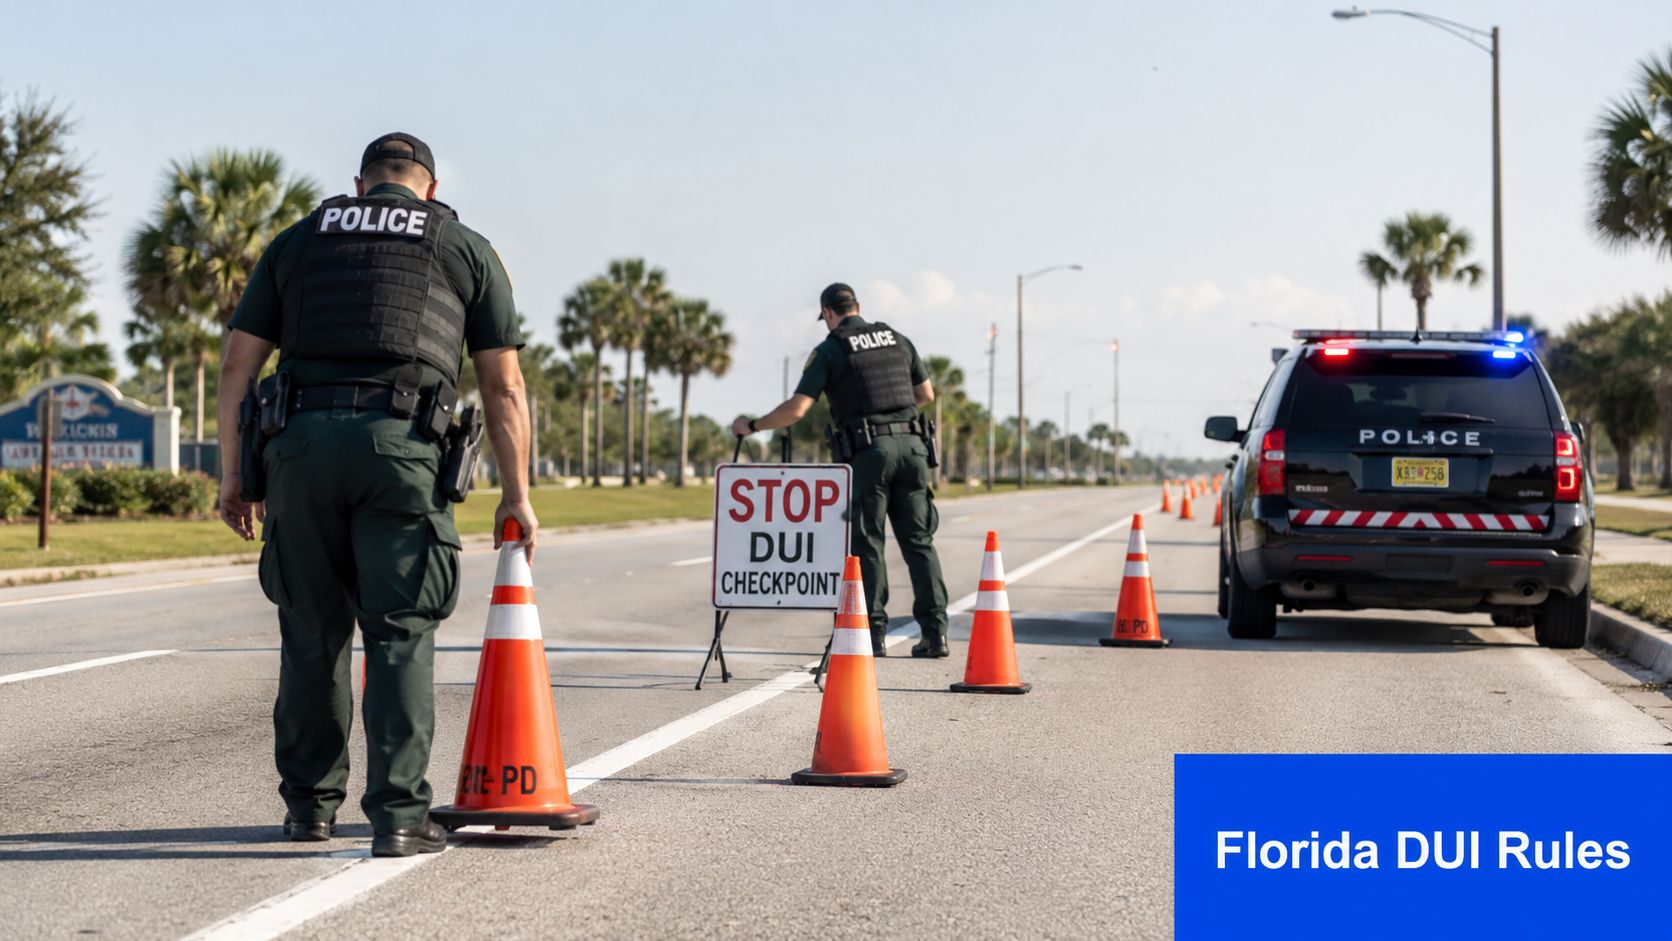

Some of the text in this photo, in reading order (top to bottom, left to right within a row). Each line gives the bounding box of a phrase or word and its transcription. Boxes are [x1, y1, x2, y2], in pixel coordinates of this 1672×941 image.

[320, 206, 428, 236] POLICE
[848, 330, 897, 352] POLICE
[1360, 429, 1480, 446] POLICE
[728, 479, 840, 524] STOP
[750, 531, 814, 563] DUI
[721, 571, 840, 596] CHECKPOINT
[501, 765, 537, 795] PD
